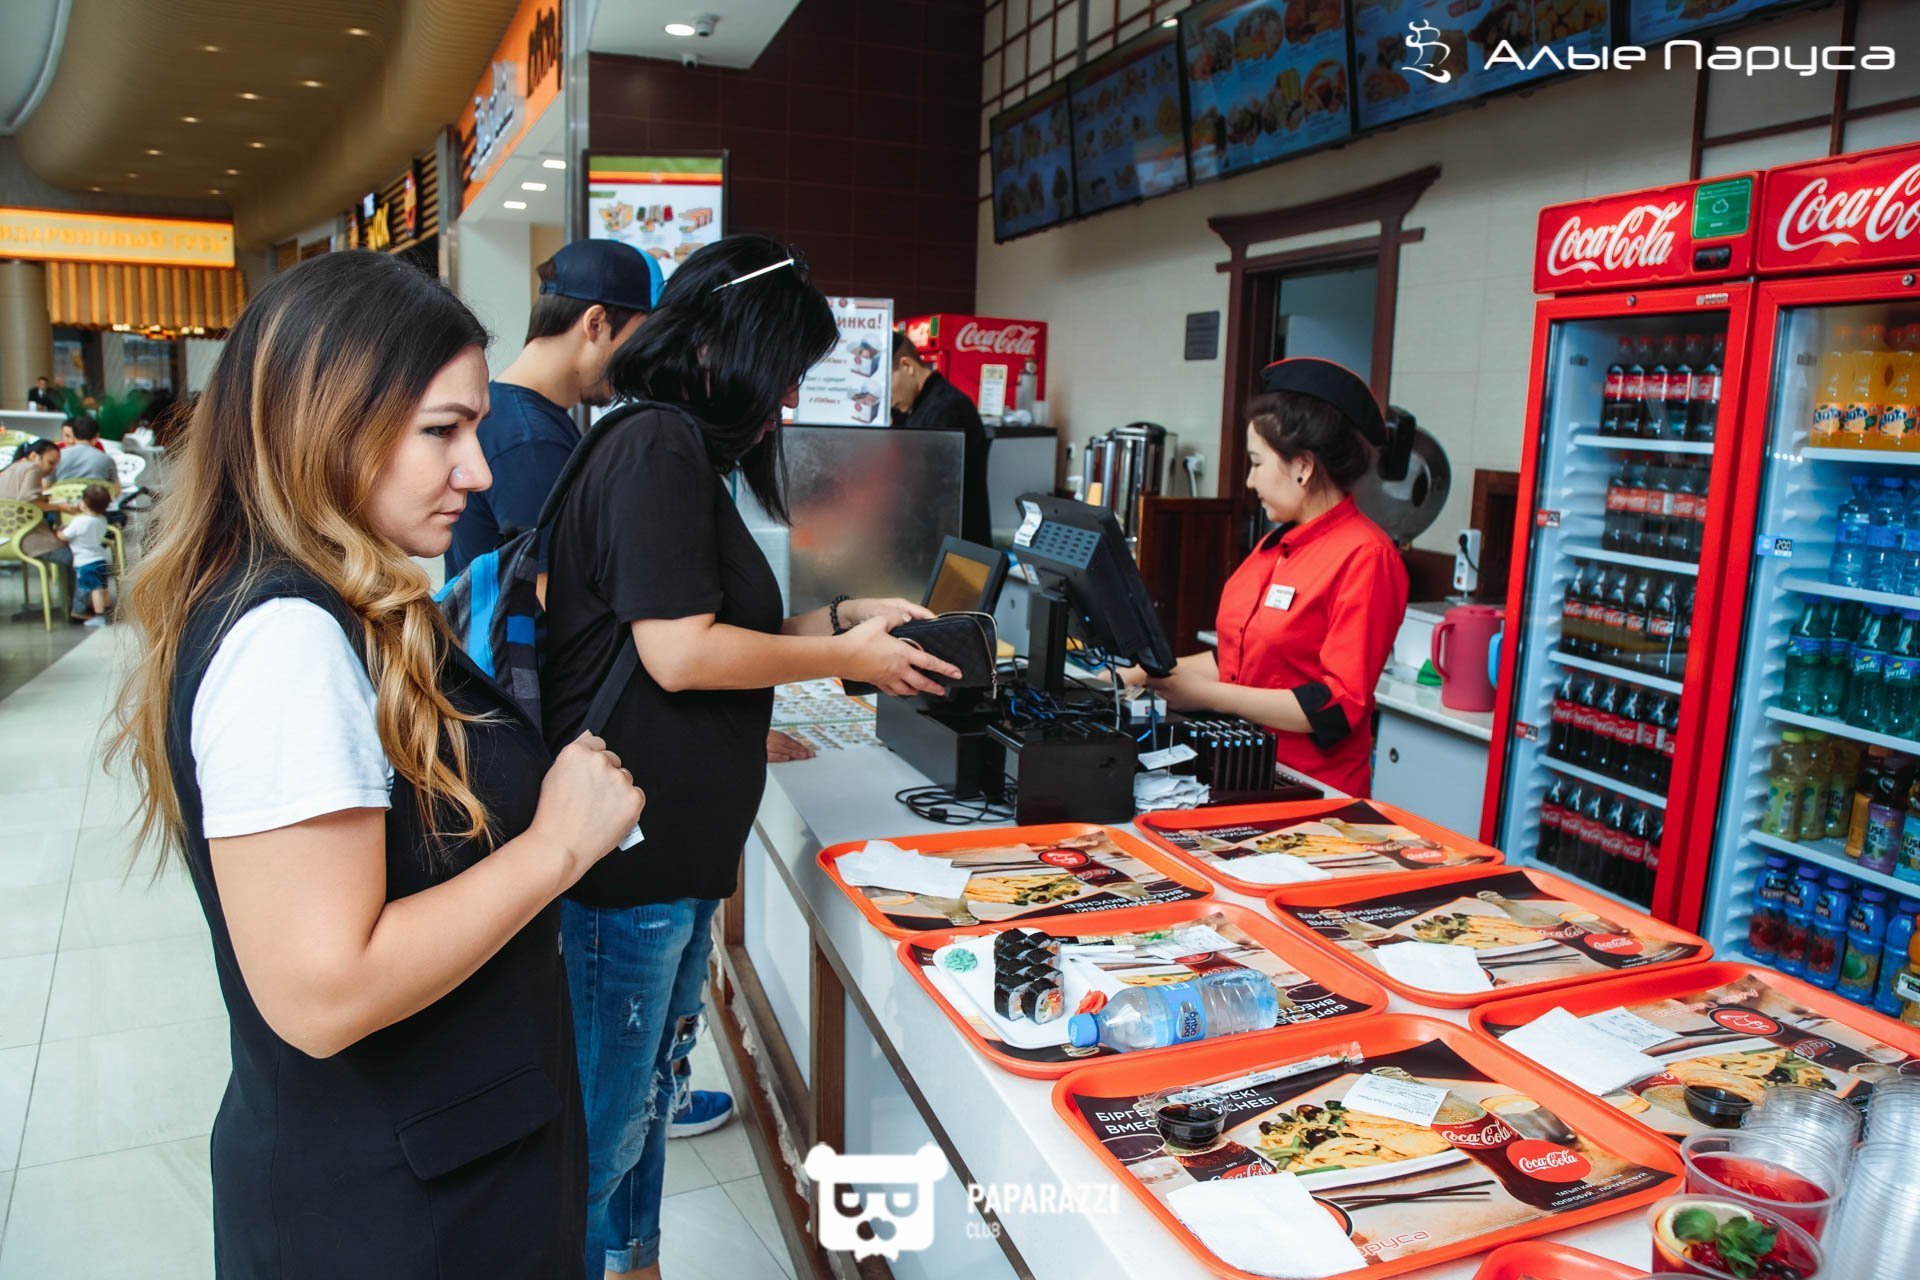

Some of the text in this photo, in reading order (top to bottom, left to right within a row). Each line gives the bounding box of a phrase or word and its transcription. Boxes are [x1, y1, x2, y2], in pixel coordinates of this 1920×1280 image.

[1547, 200, 1687, 276] Coca-Cola
[836, 313, 883, 329] инка!
[955, 322, 1040, 355] Coca-Cola
[1096, 1109, 1151, 1122] БІРГЕ
[1105, 1119, 1157, 1134] ВМЕС
[1441, 1120, 1514, 1147] Coca-Cola
[1519, 1149, 1578, 1173] Coca-Cola
